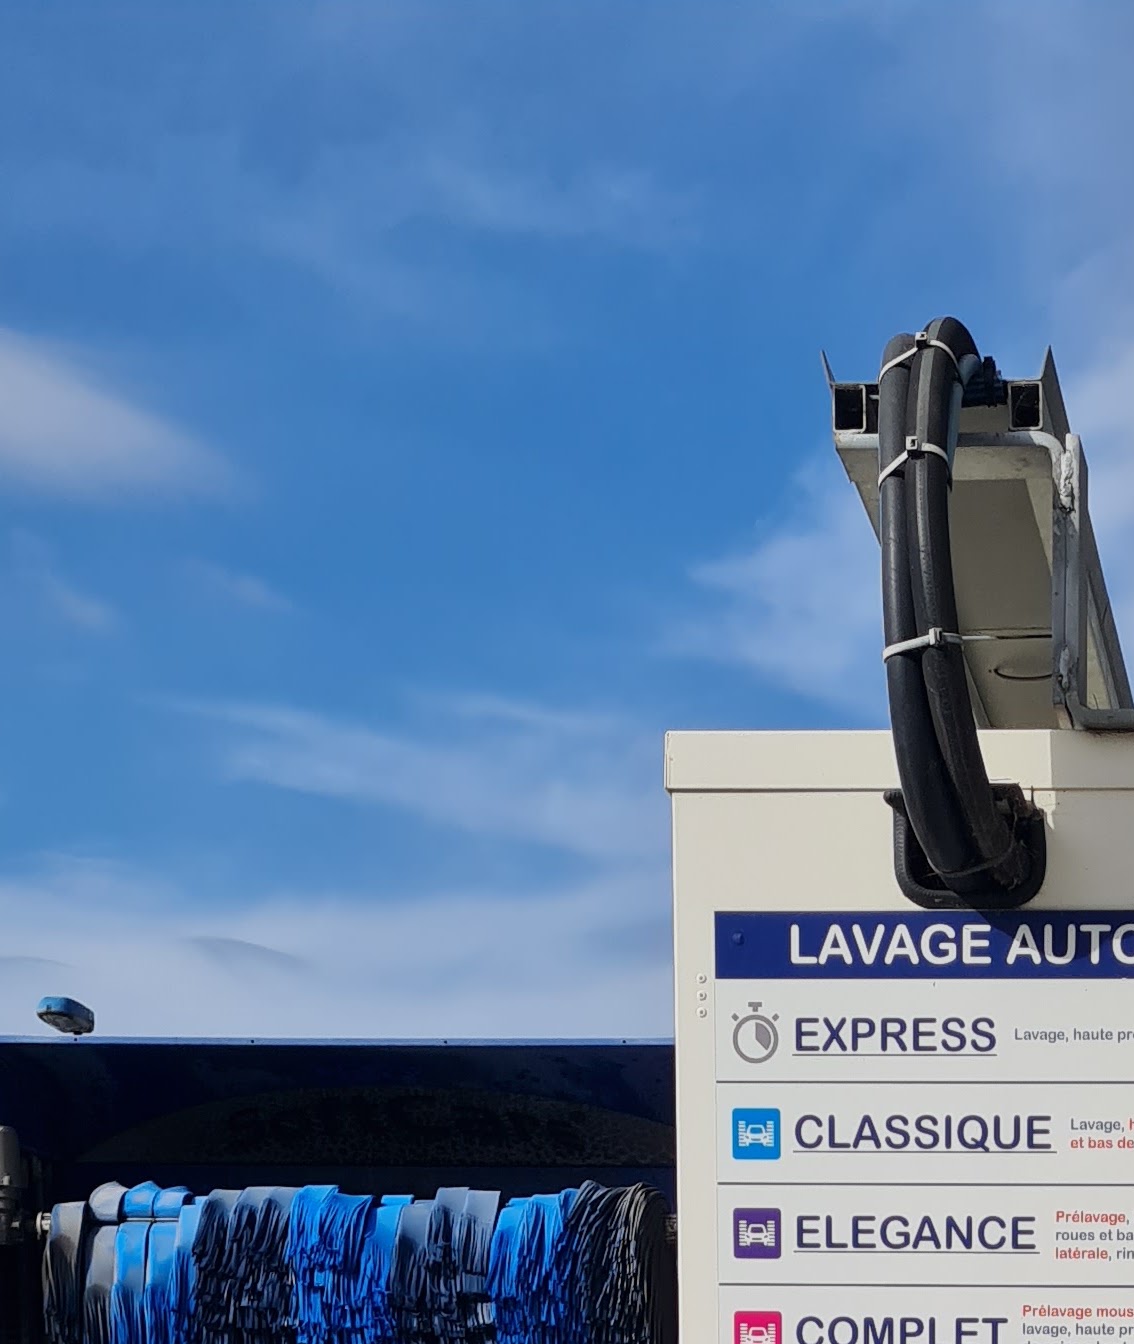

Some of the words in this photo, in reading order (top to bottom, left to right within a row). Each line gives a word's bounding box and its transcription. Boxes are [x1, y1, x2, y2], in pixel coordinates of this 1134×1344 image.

[789, 923, 993, 966] LAVAGE
[794, 1017, 997, 1053] EXPRESS
[1014, 1028, 1069, 1043] Lavage,
[1073, 1028, 1114, 1041] haute
[1070, 1118, 1126, 1133] Lavage,
[794, 1114, 1053, 1153] CLASSIQUE
[1070, 1136, 1085, 1149] et
[1088, 1136, 1113, 1149] bas
[1117, 1136, 1134, 1149] de
[1055, 1210, 1130, 1225] Prélavage,
[795, 1215, 1038, 1251] ELEGANCE
[1055, 1230, 1095, 1241] roues
[1099, 1229, 1114, 1241] et
[1055, 1247, 1112, 1261] latérale,
[1022, 1304, 1092, 1320] Prélavage
[1022, 1323, 1071, 1338] lavage,
[1075, 1323, 1115, 1336] haute
